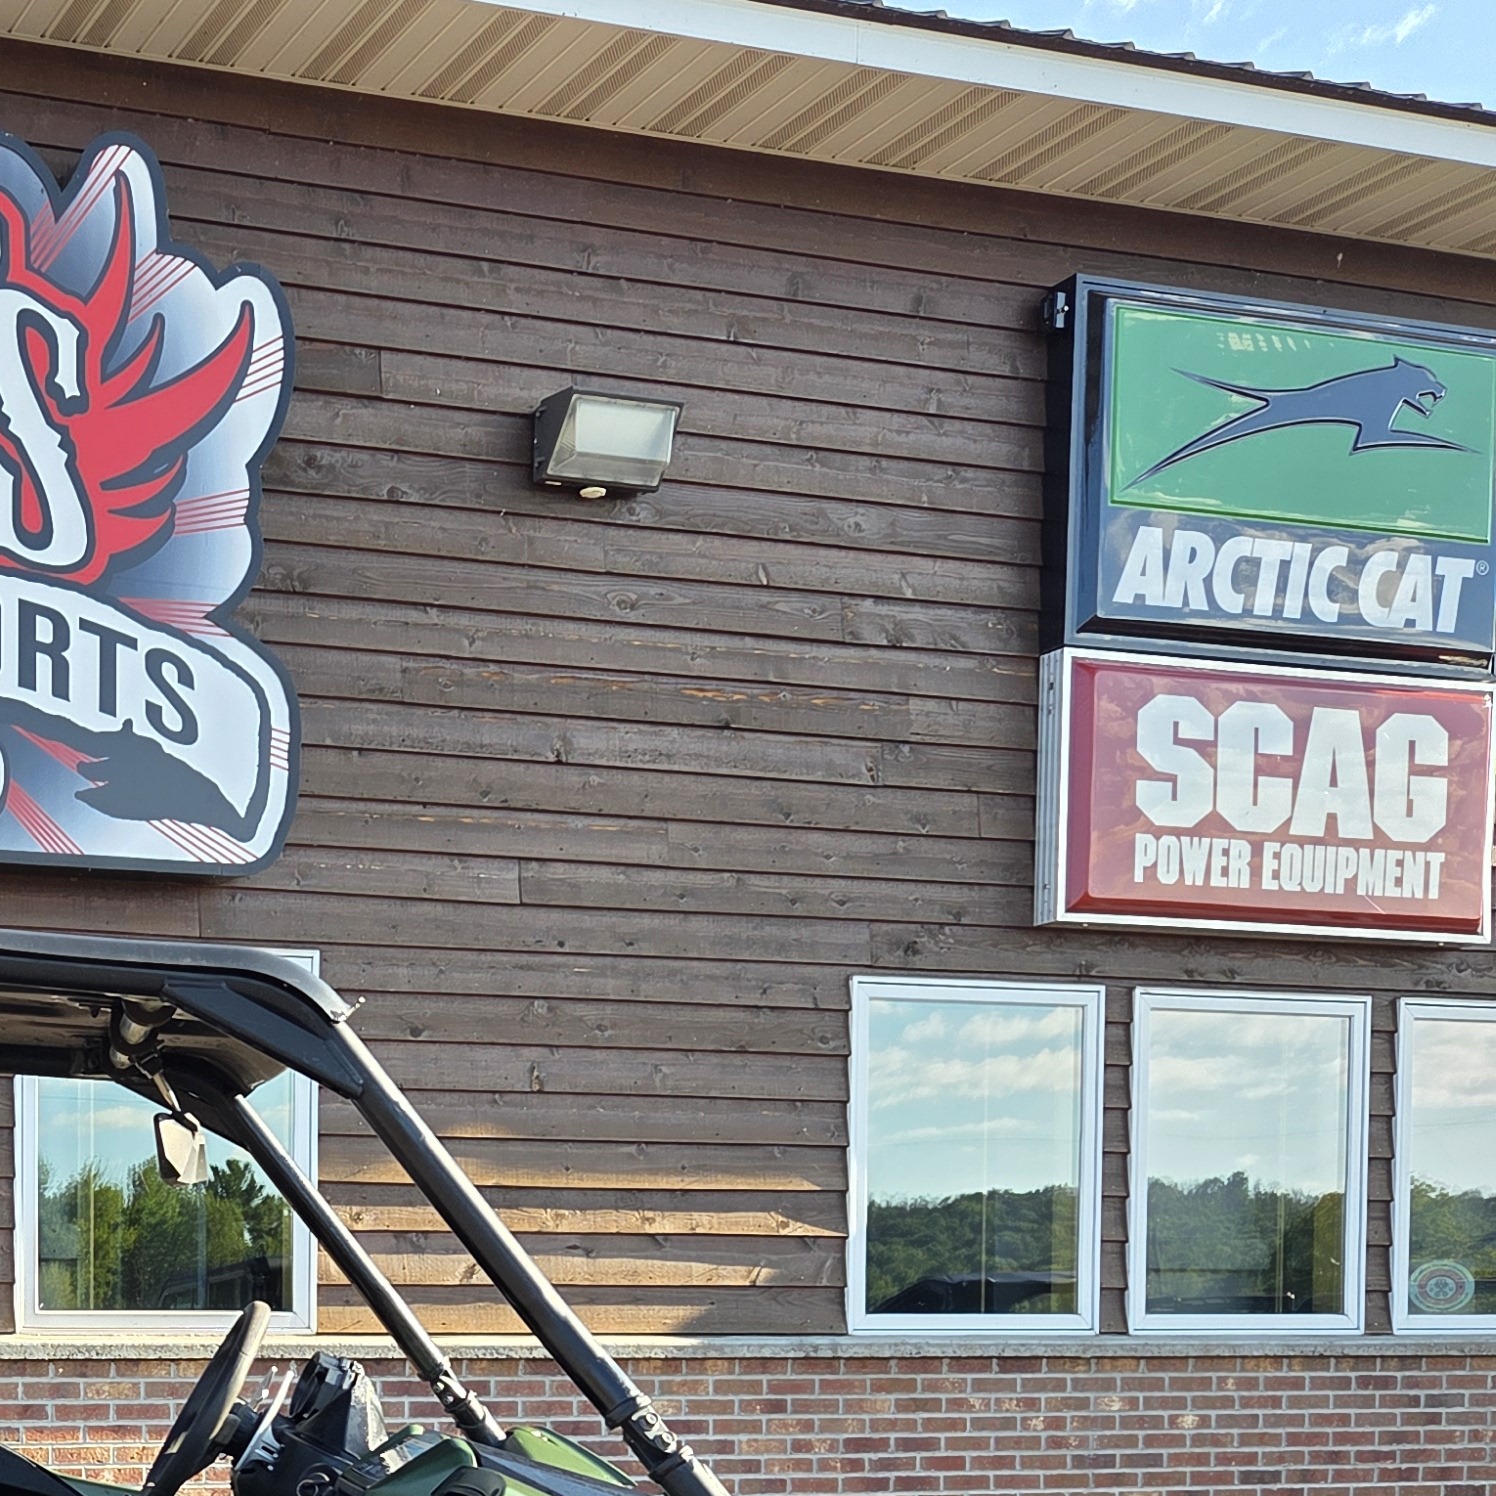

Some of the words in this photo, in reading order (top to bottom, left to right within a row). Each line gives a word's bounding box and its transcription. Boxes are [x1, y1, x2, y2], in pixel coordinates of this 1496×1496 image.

[1112, 526, 1349, 623] ARCTIC
[1358, 552, 1476, 633] CAT
[1135, 693, 1449, 843] SCAG
[1135, 834, 1251, 888] POWER
[1262, 842, 1445, 900] EQUIPMENT
